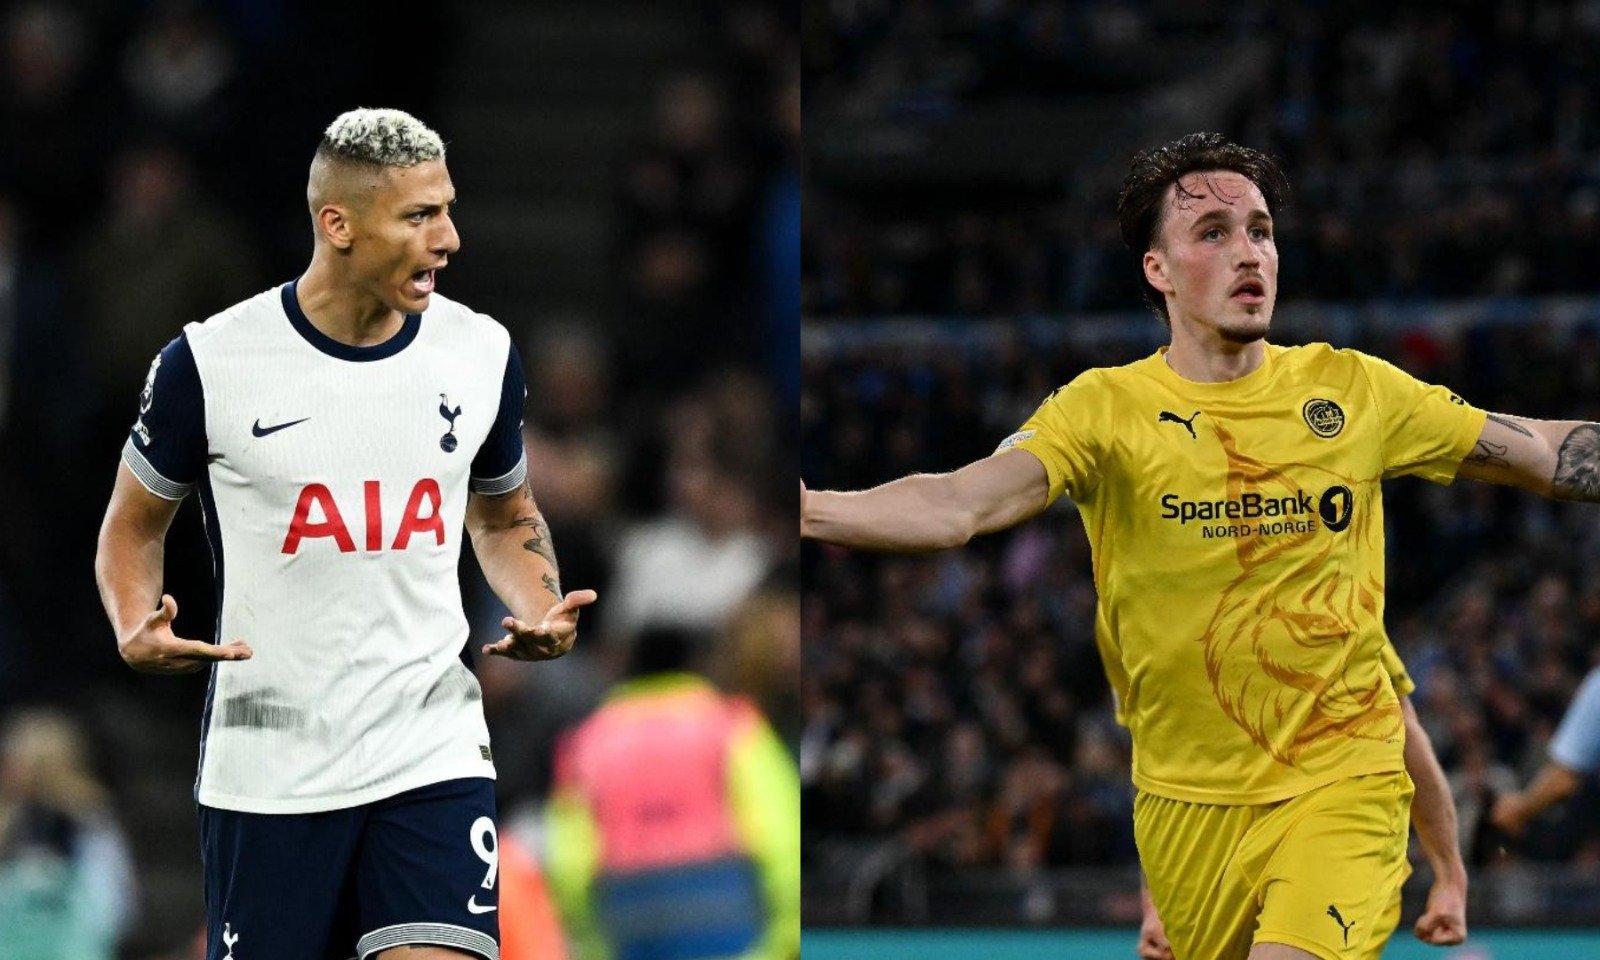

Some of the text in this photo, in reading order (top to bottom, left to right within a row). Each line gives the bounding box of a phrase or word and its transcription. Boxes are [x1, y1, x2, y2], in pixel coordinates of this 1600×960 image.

[281, 478, 445, 555] AIA
[1161, 489, 1315, 524] SpareBank
[1202, 520, 1317, 538] NORD-NORGE
[469, 815, 499, 890] 9
